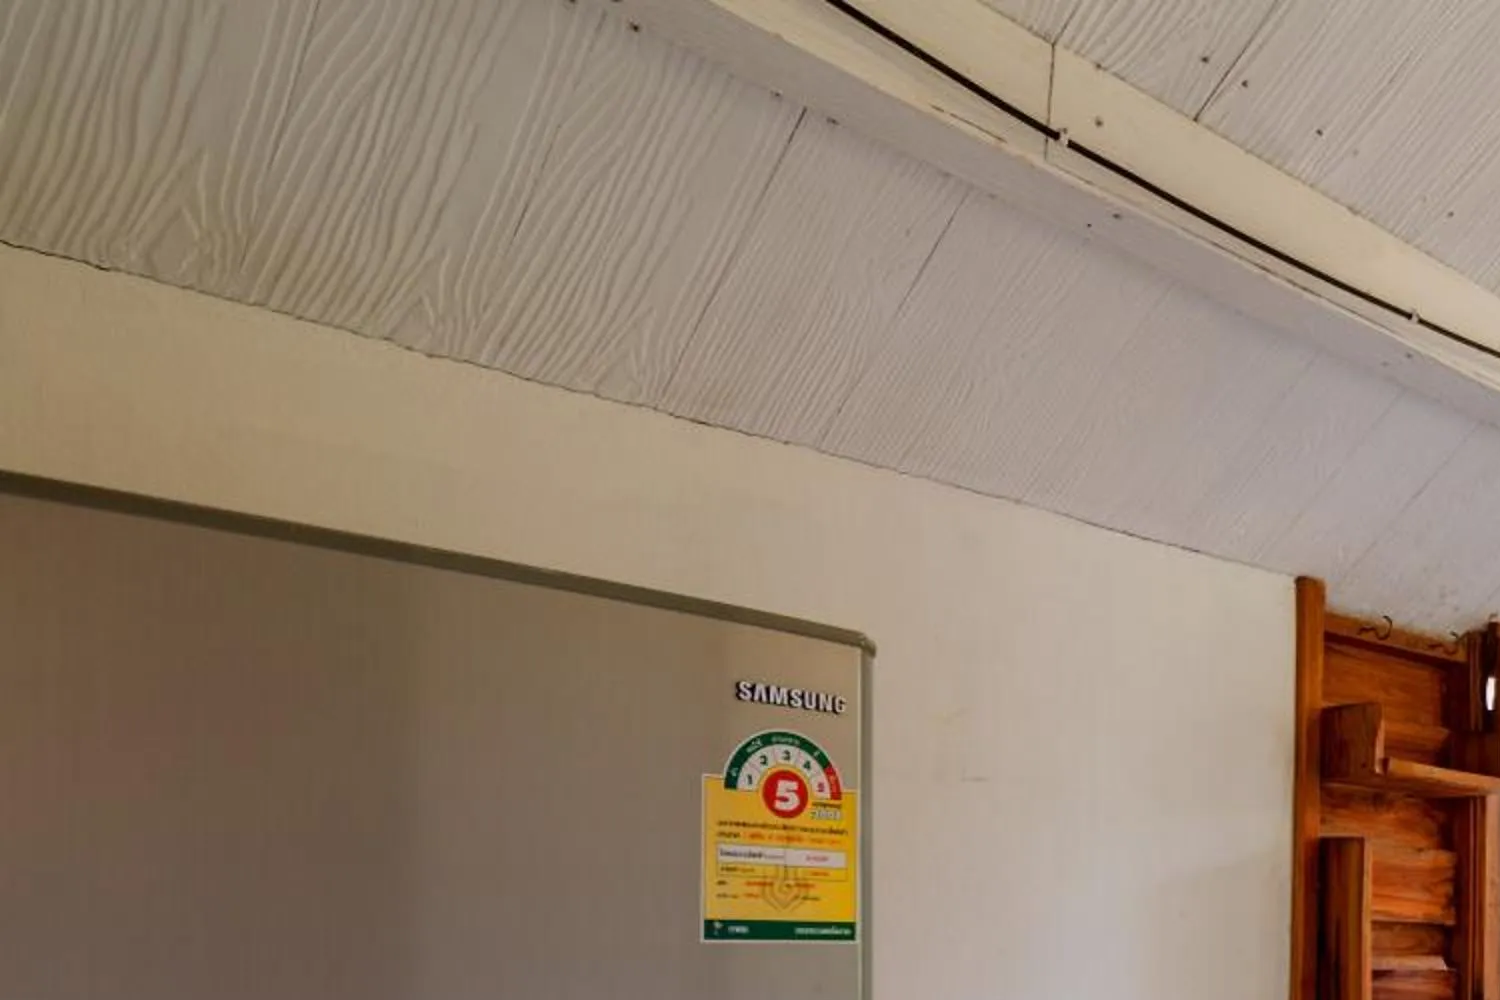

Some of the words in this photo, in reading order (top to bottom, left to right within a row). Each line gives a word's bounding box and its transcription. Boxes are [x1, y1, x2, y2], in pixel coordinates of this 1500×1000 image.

[737, 680, 847, 714] SAMSUNG
[746, 773, 753, 786] 1
[759, 754, 769, 766] 2
[782, 749, 791, 761] 3
[803, 760, 812, 771] 4
[773, 779, 801, 812] 5
